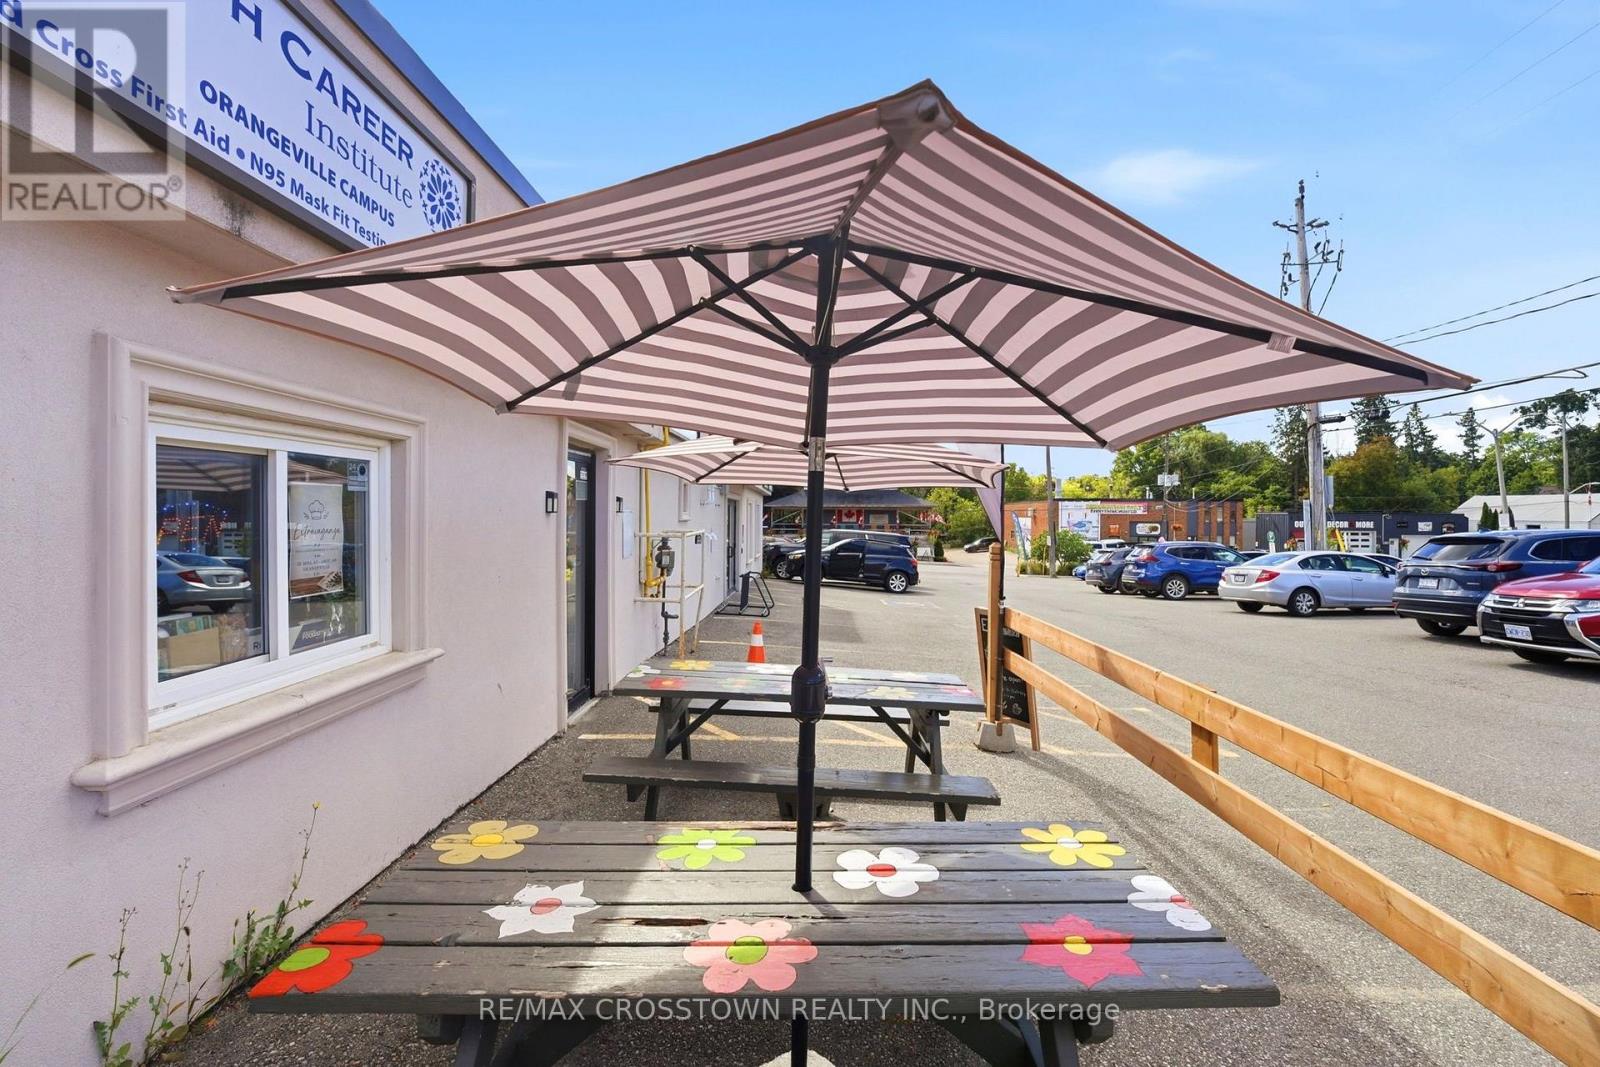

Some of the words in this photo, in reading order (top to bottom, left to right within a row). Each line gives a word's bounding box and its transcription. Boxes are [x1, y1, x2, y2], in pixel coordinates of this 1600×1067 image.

[36, 19, 123, 88] Cross
[131, 75, 187, 129] First
[194, 117, 229, 155] Aid
[250, 152, 285, 187] N95
[290, 178, 329, 216] Mask
[333, 205, 349, 229] Fit
[352, 217, 386, 246] Testin
[199, 80, 336, 188] ORANGEVILLE
[339, 178, 395, 227] CAMPUS
[280, 30, 414, 170] CAREER
[305, 100, 412, 208] Institute
[1355, 520, 1375, 529] MORE
